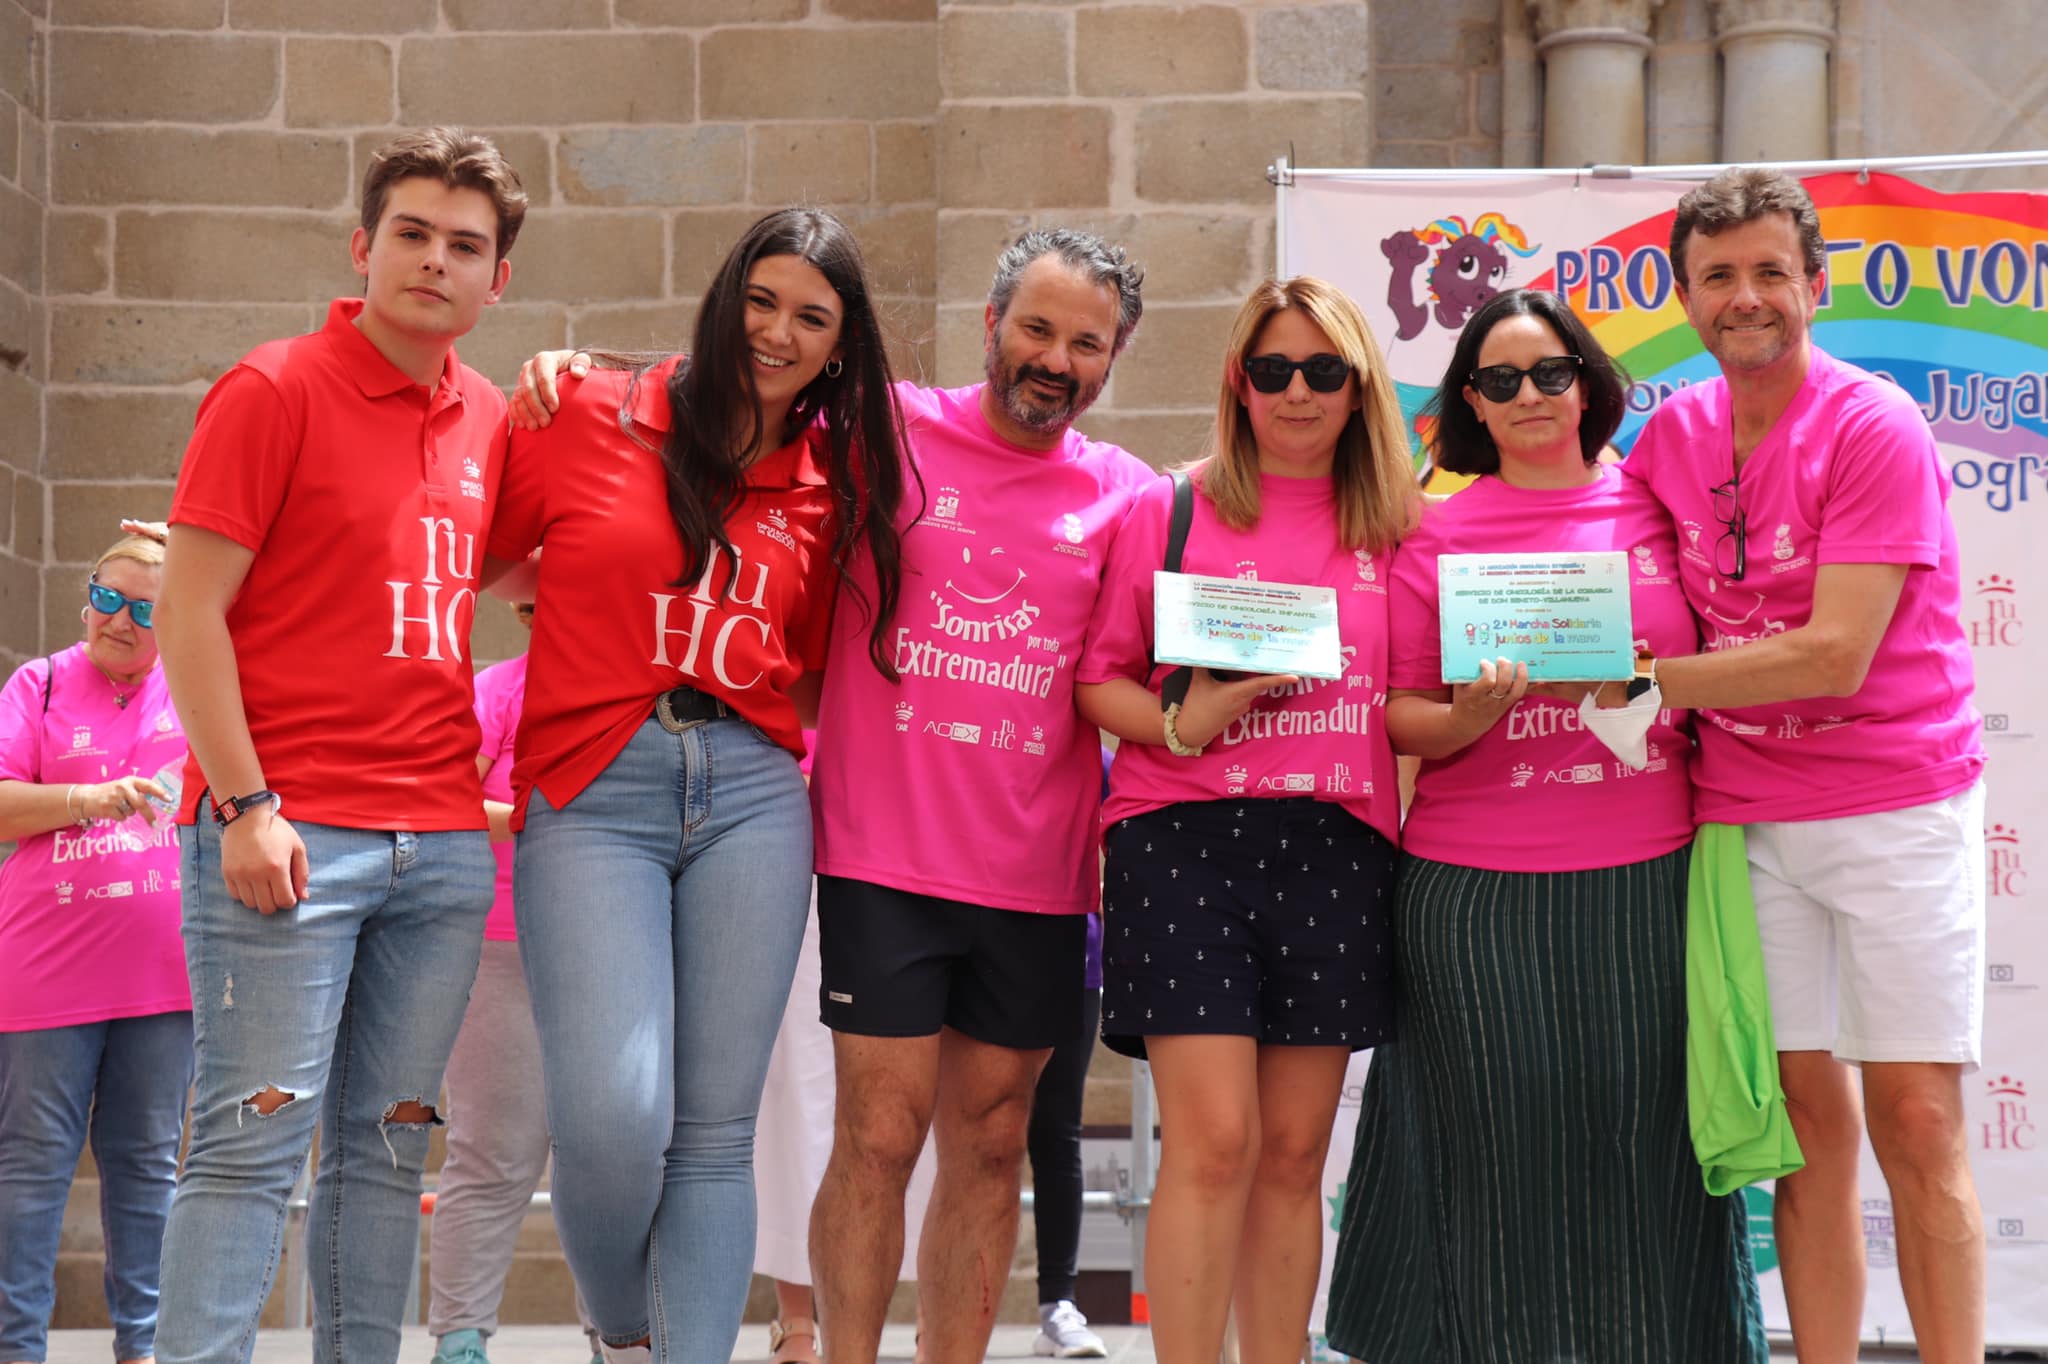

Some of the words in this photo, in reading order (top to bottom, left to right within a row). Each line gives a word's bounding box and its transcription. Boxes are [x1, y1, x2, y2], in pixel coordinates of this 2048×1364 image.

[419, 516, 474, 584] ru
[383, 581, 476, 664] HC
[1223, 619, 1264, 631] Marcha
[1509, 618, 1550, 629] Marcha
[1552, 618, 1602, 629] Solidaria
[648, 592, 771, 690] HC
[1026, 635, 1042, 650] por
[1534, 632, 1549, 643] de
[1554, 631, 1565, 643] la
[1567, 634, 1600, 644] mano
[1971, 620, 2023, 647] HC
[1348, 674, 1362, 690] por
[990, 731, 1016, 750] HC
[1326, 775, 1352, 793] HC
[1982, 1123, 2036, 1150] HC
